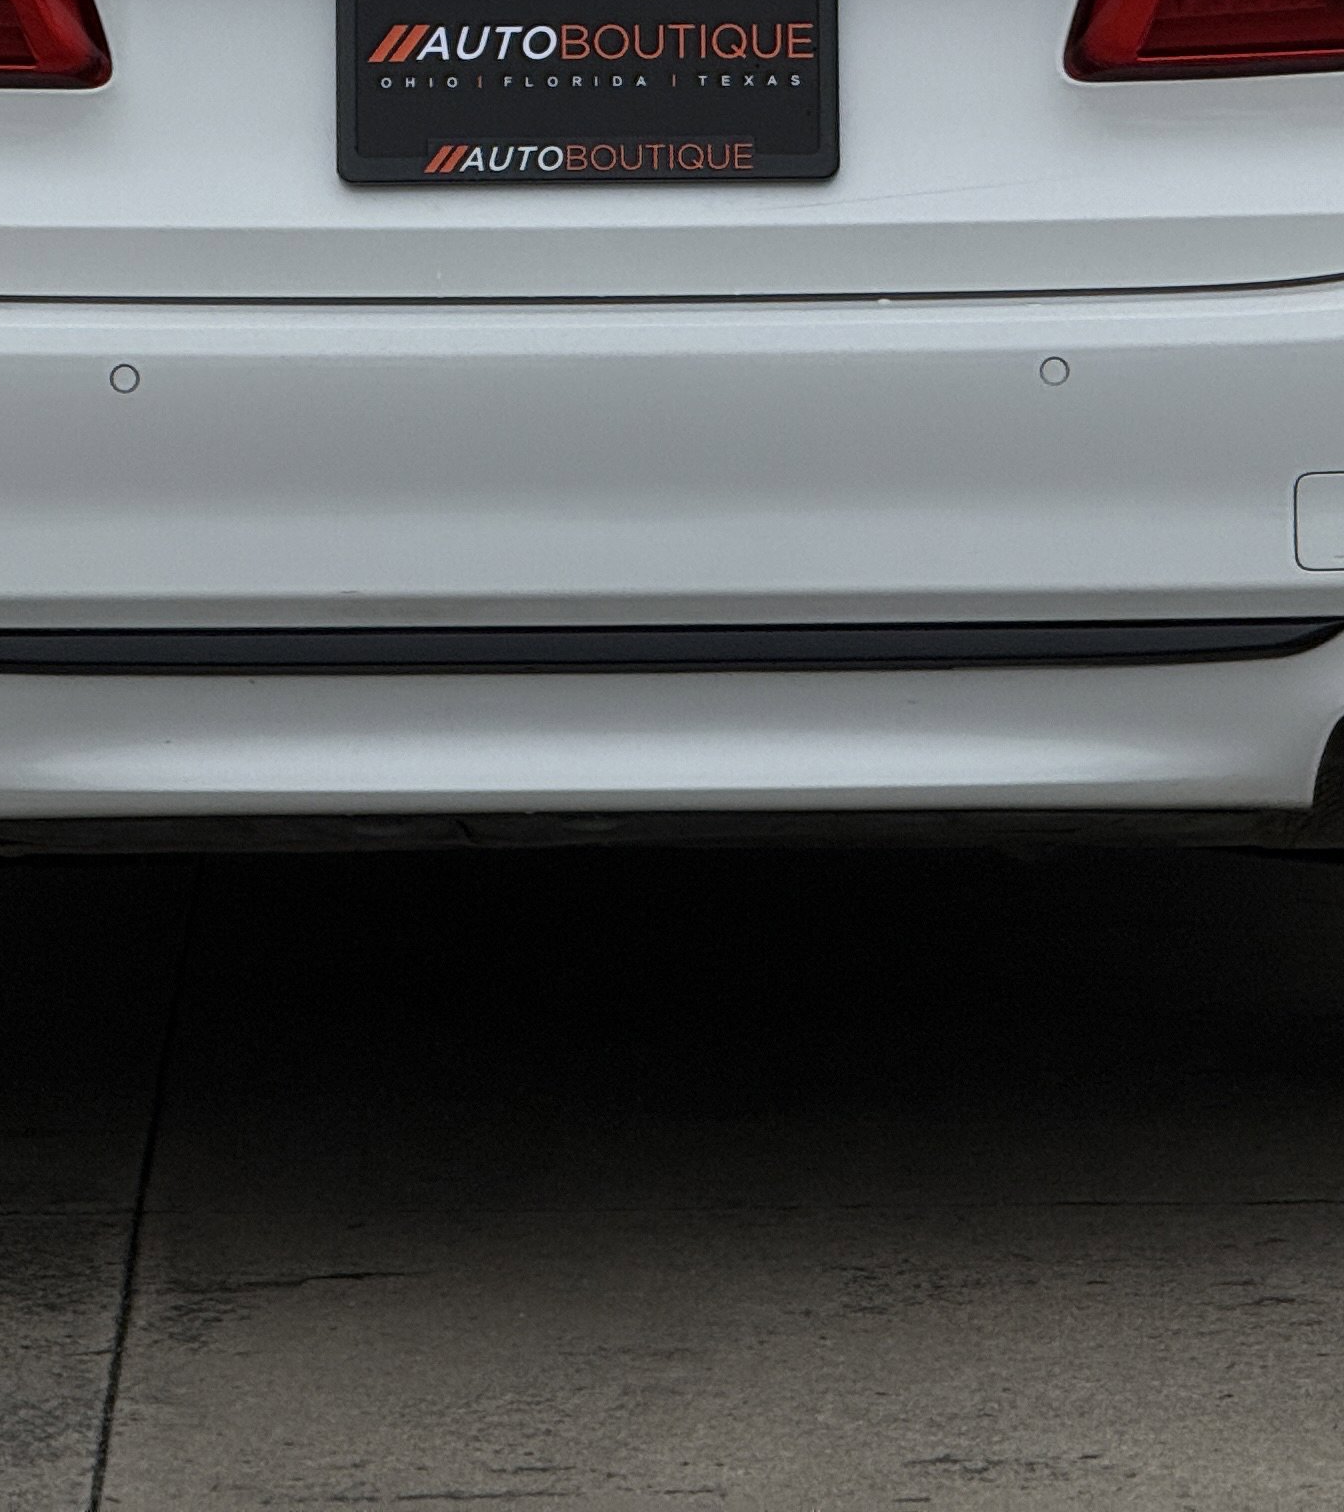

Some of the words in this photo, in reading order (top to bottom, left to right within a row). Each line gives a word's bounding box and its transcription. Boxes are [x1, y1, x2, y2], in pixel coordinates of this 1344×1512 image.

[380, 75, 458, 89] OHIO
[504, 74, 648, 88] FLORIDA
[698, 74, 802, 87] TEXAS
